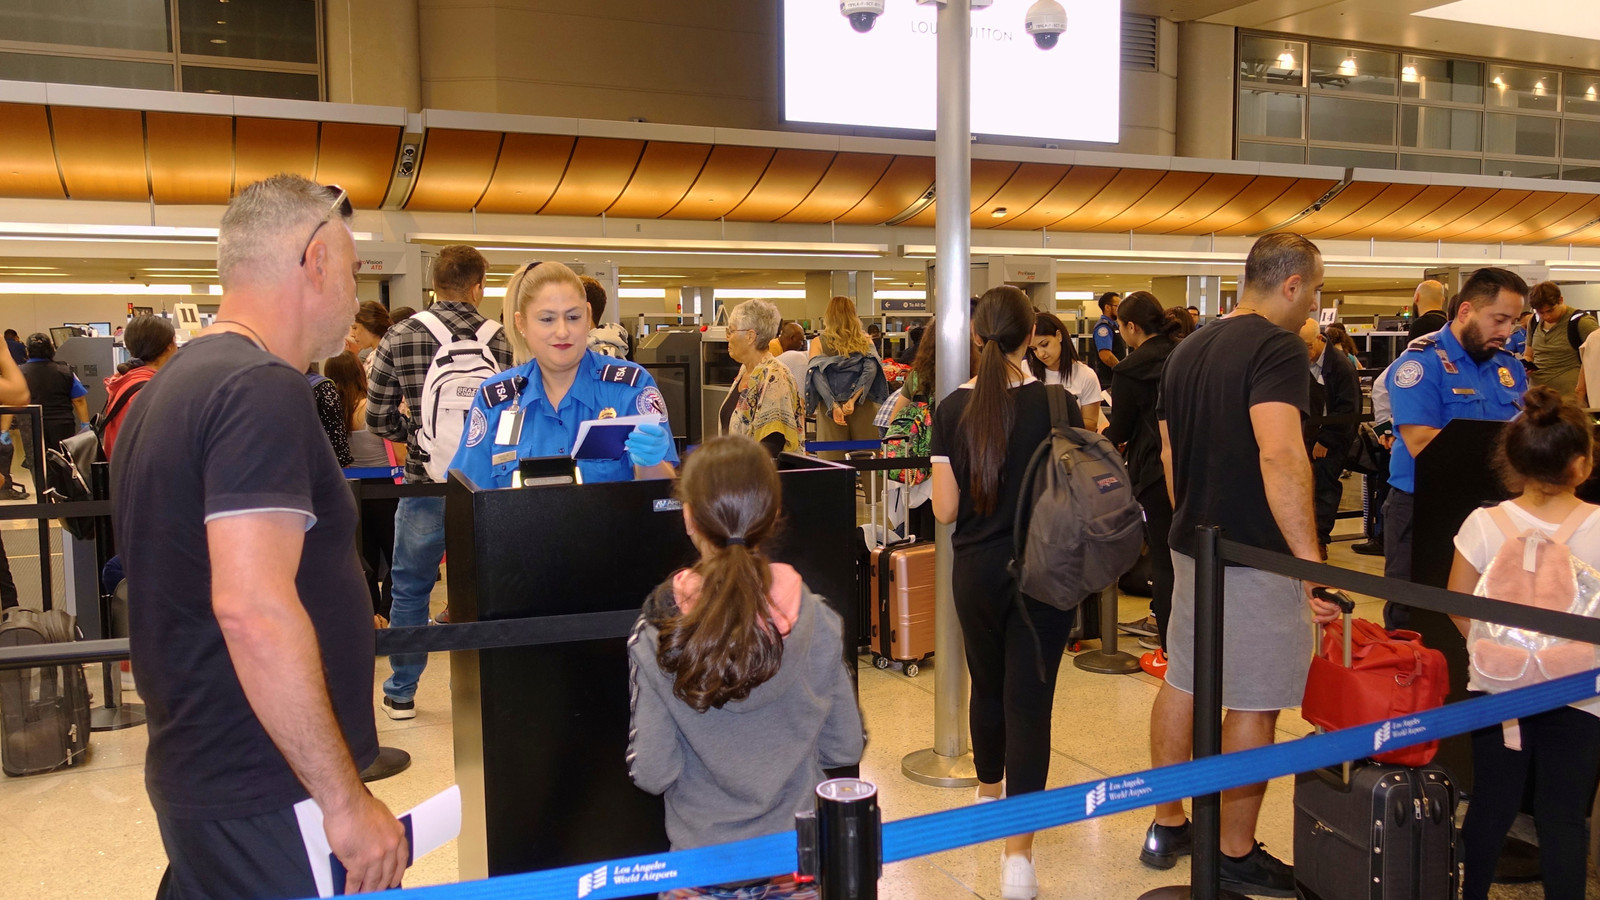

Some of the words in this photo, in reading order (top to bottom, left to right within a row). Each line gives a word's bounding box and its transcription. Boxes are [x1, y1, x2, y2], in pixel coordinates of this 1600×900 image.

[911, 21, 938, 35] LOU
[180, 308, 199, 323] 11
[1322, 312, 1334, 322] 14
[614, 366, 628, 382] TSA
[494, 381, 508, 402] TSA
[1109, 782, 1121, 791] Los
[1122, 776, 1145, 789] Angeles
[1109, 790, 1128, 801] World
[1128, 787, 1153, 798] Airports
[613, 866, 631, 876] Los
[632, 860, 666, 873] Angeles
[613, 873, 641, 885] World
[640, 869, 678, 882] Airports
